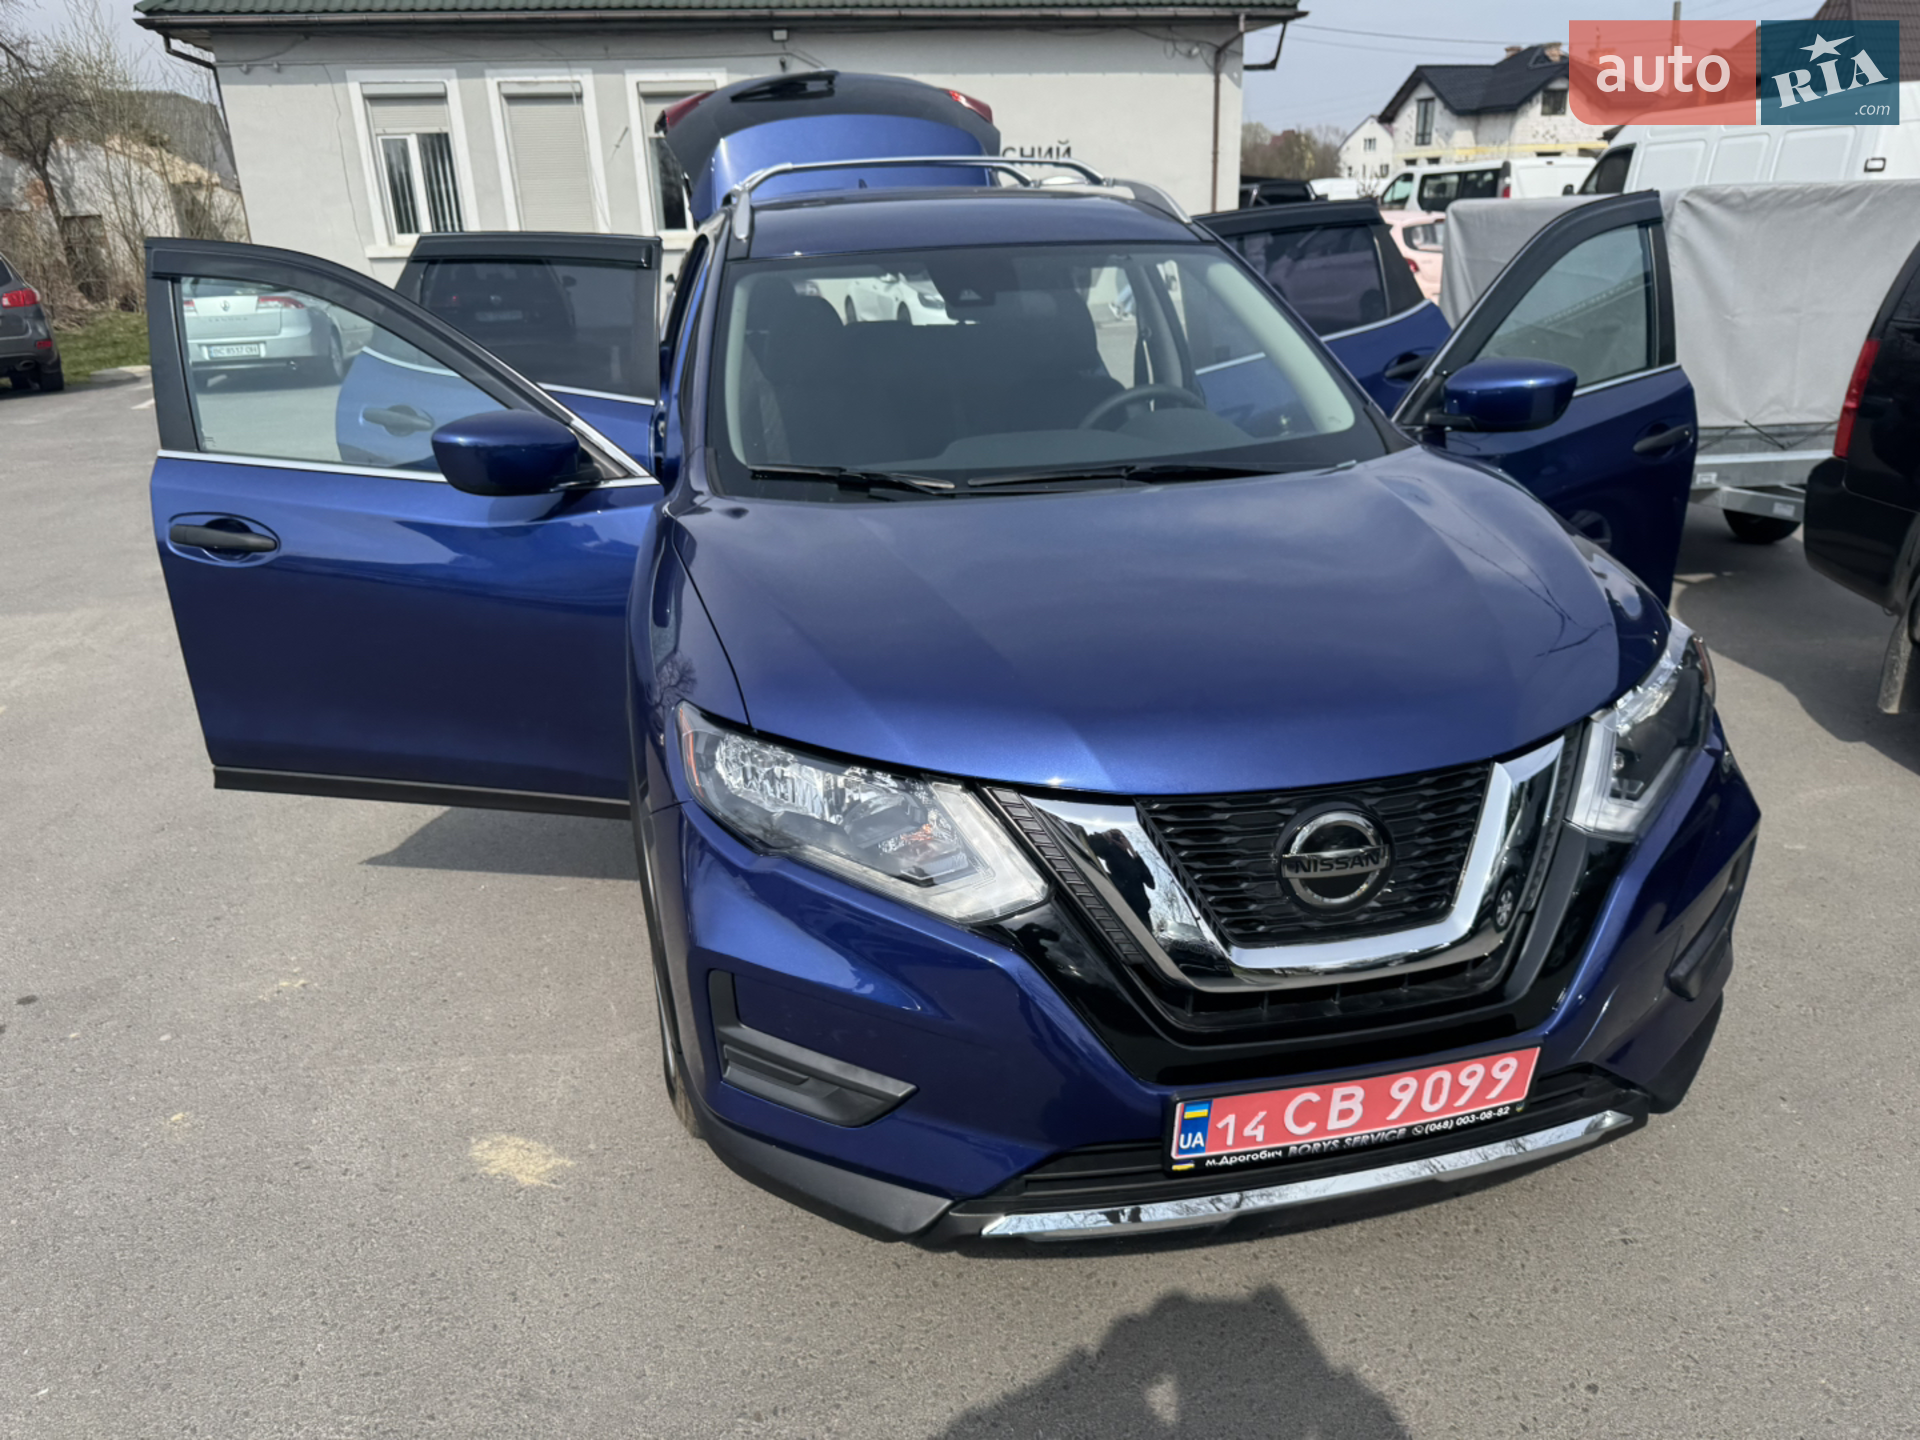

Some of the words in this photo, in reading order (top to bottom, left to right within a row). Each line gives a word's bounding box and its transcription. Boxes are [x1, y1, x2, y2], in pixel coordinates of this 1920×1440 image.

[1295, 852, 1380, 873] NISSAN
[1216, 1111, 1267, 1147] 14
[1283, 1085, 1365, 1136] CB
[1386, 1057, 1519, 1121] 9099
[1179, 1132, 1205, 1150] UA
[1288, 1139, 1340, 1158] BORYS
[1343, 1128, 1407, 1149] SERVICE
